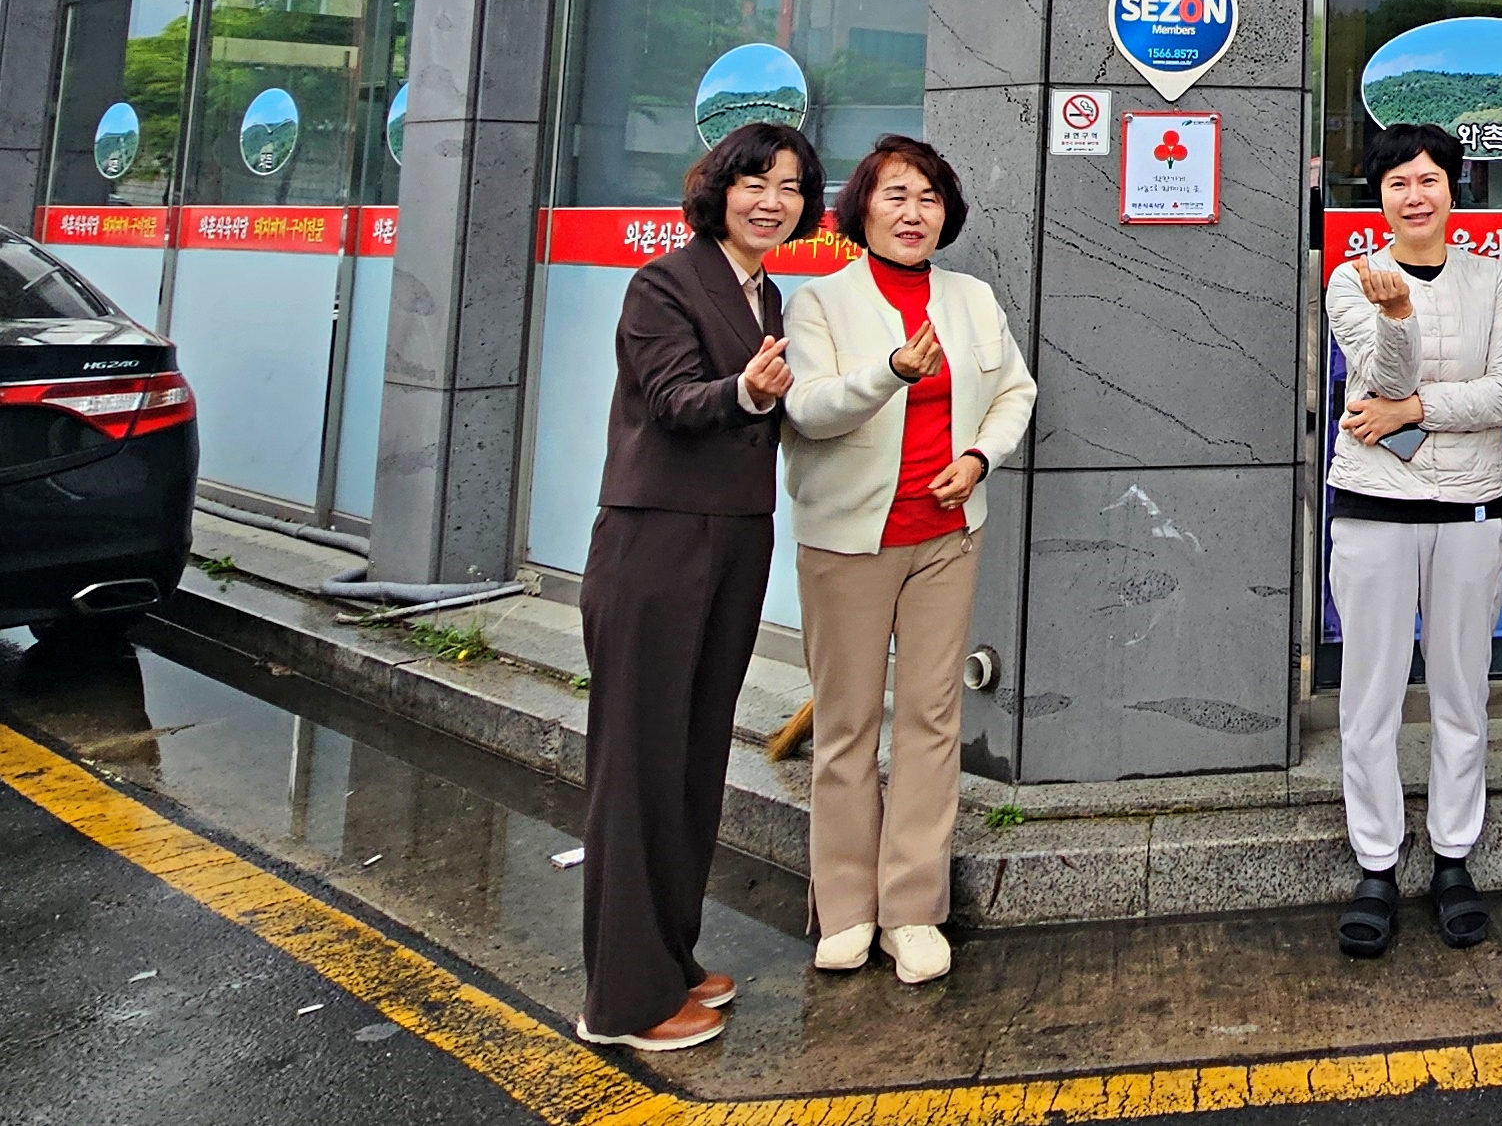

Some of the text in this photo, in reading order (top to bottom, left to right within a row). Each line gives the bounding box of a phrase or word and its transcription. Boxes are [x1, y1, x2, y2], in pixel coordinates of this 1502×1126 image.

[1151, 24, 1196, 35] Members
[1147, 47, 1199, 59] 1566.8573
[198, 215, 249, 241] 와촌식육식당
[372, 216, 399, 245] 와촌
[624, 220, 696, 254] 와촌식육
